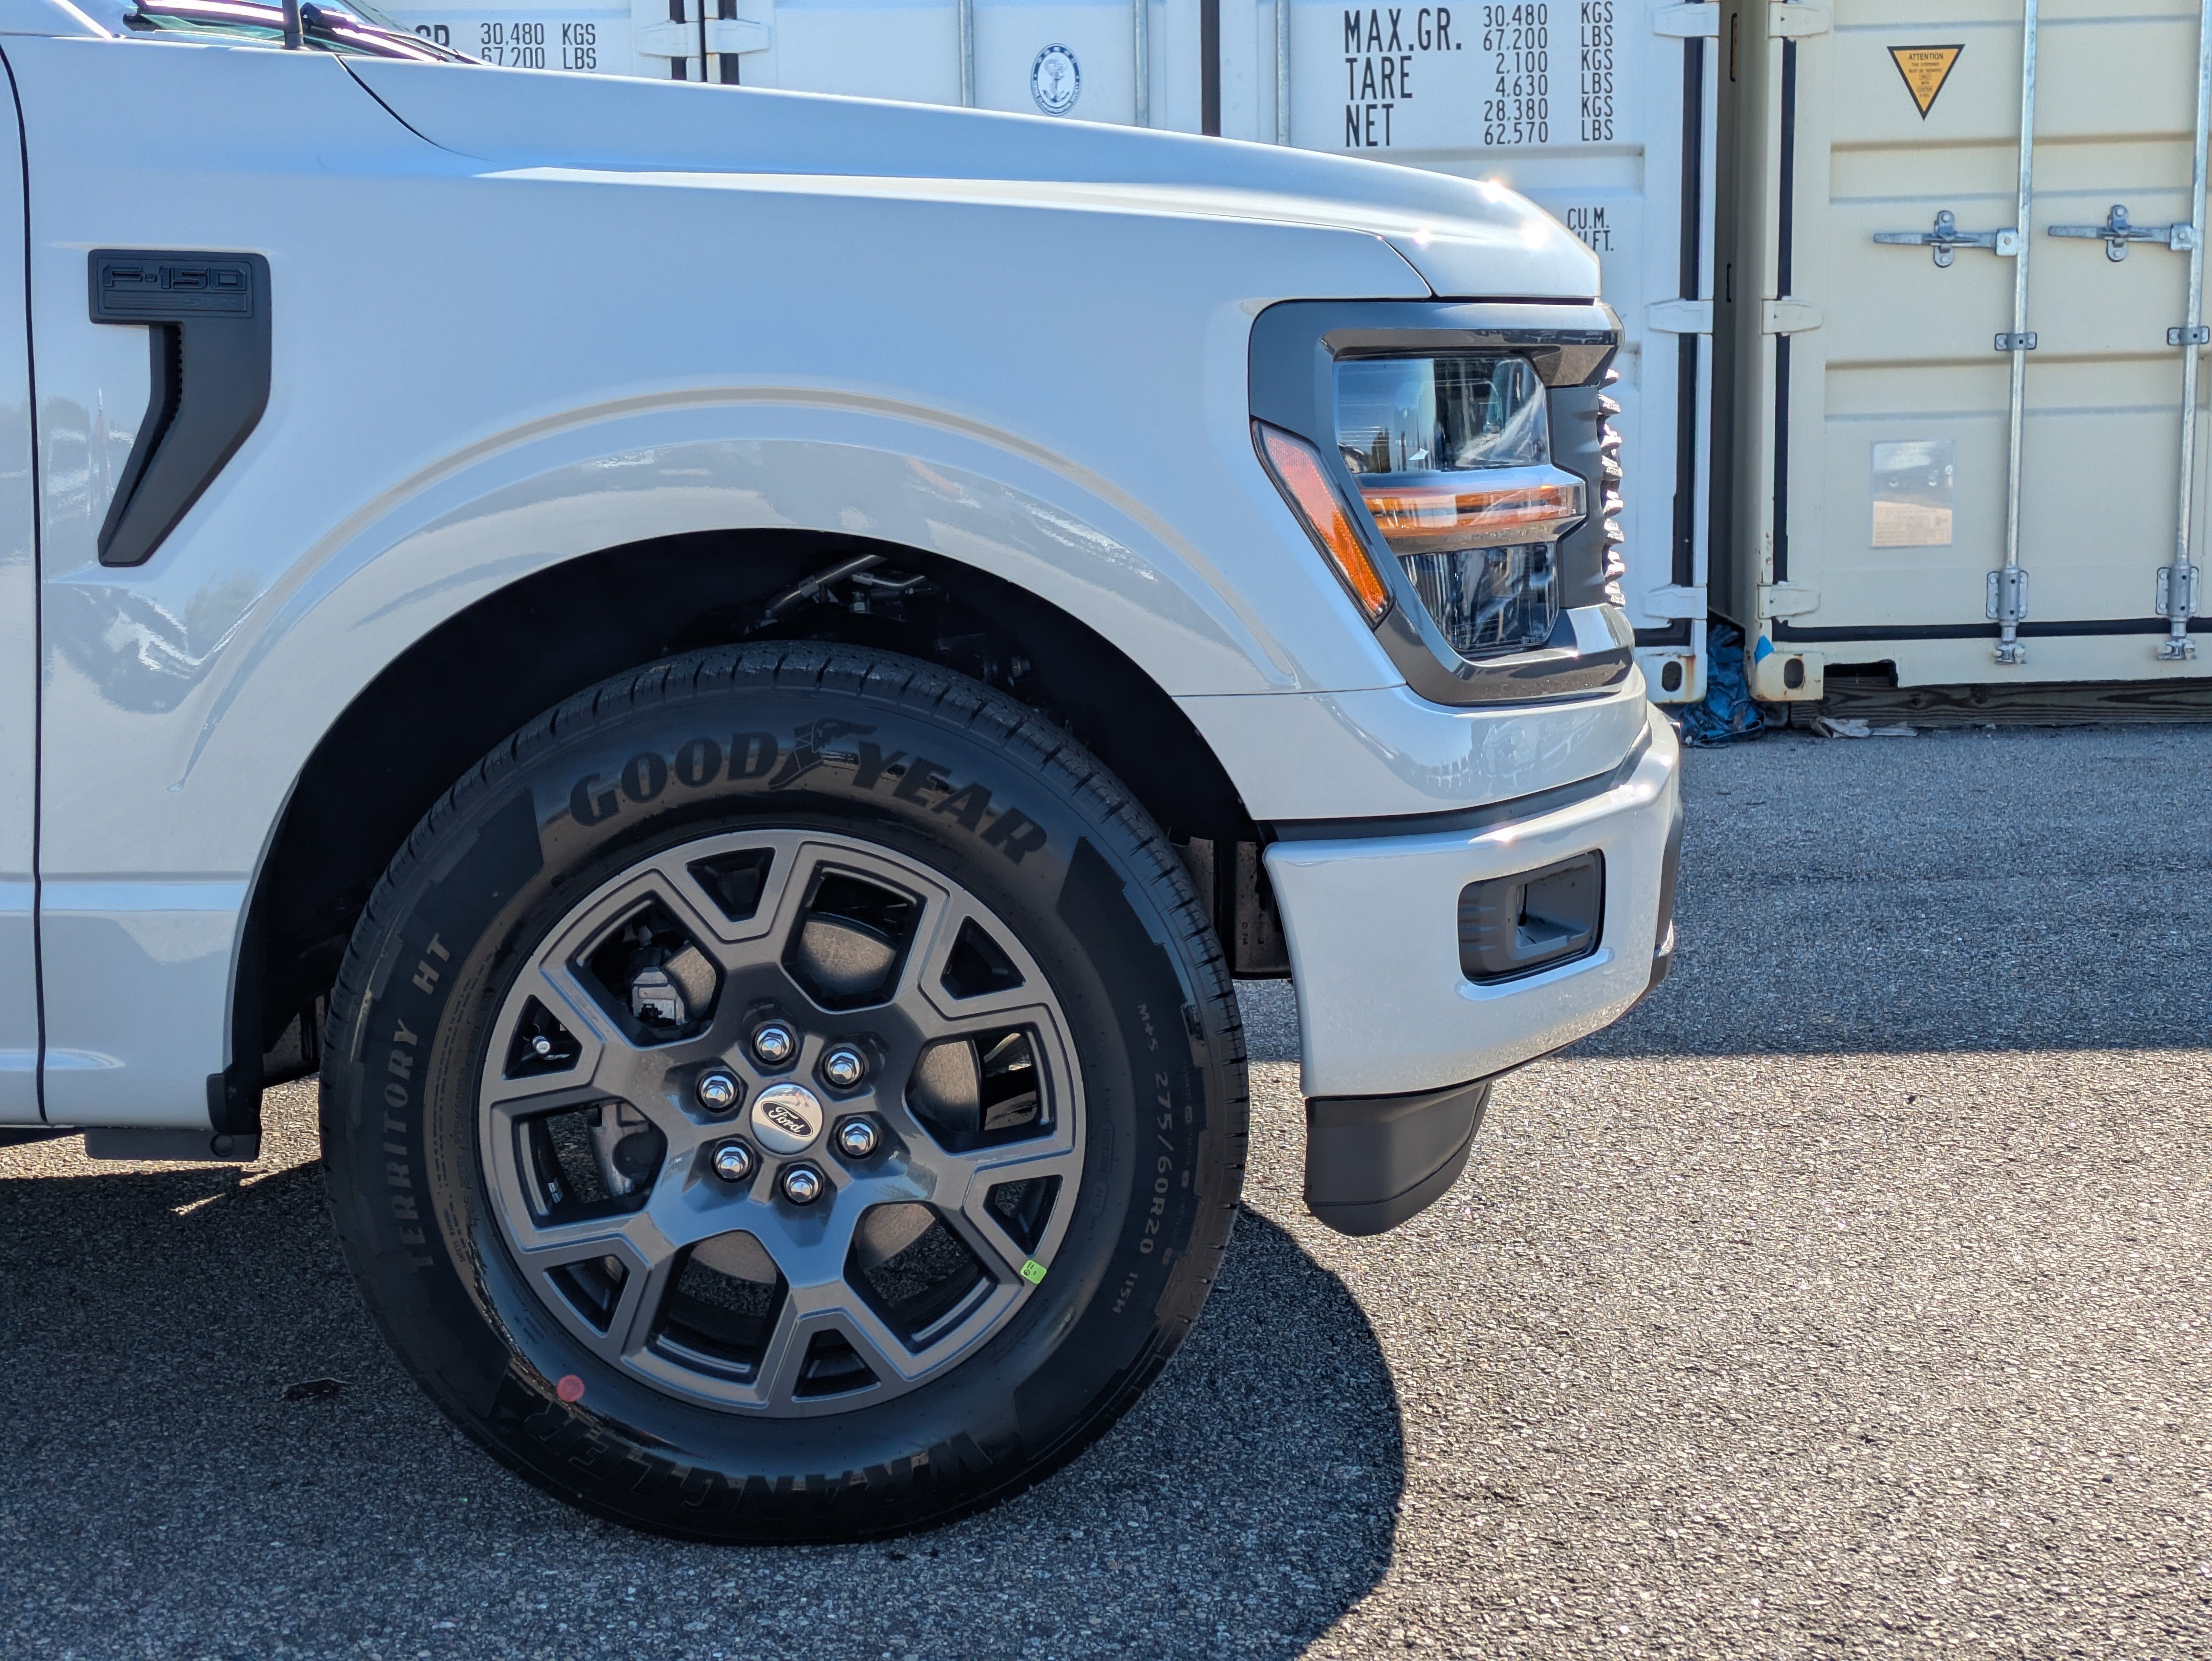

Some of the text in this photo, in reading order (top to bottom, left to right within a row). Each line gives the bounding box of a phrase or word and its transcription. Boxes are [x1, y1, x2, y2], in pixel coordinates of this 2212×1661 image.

[563, 23, 596, 45] KGS
[1344, 8, 1462, 53] MAX.GR.
[1581, 1, 1614, 23] KGS
[1581, 25, 1614, 47] LBS
[482, 46, 597, 69] 67200 LBS
[1345, 55, 1413, 100] TARE
[1581, 49, 1614, 71] KGS
[1581, 72, 1614, 94] LBS
[1346, 103, 1394, 147] NET
[1581, 95, 1614, 118] KGS
[1581, 119, 1614, 141] LBS
[1568, 207, 1609, 230] CU.M.
[102, 264, 246, 291] F-150
[183, 296, 239, 308] STX
[1137, 1003, 1159, 1052] M+S
[382, 1018, 436, 1276] TERRITORY
[411, 932, 452, 996] HT
[767, 1106, 806, 1133] Ford
[1139, 1071, 1175, 1255] 275/60R20
[523, 1397, 994, 1515] WRANGLER
